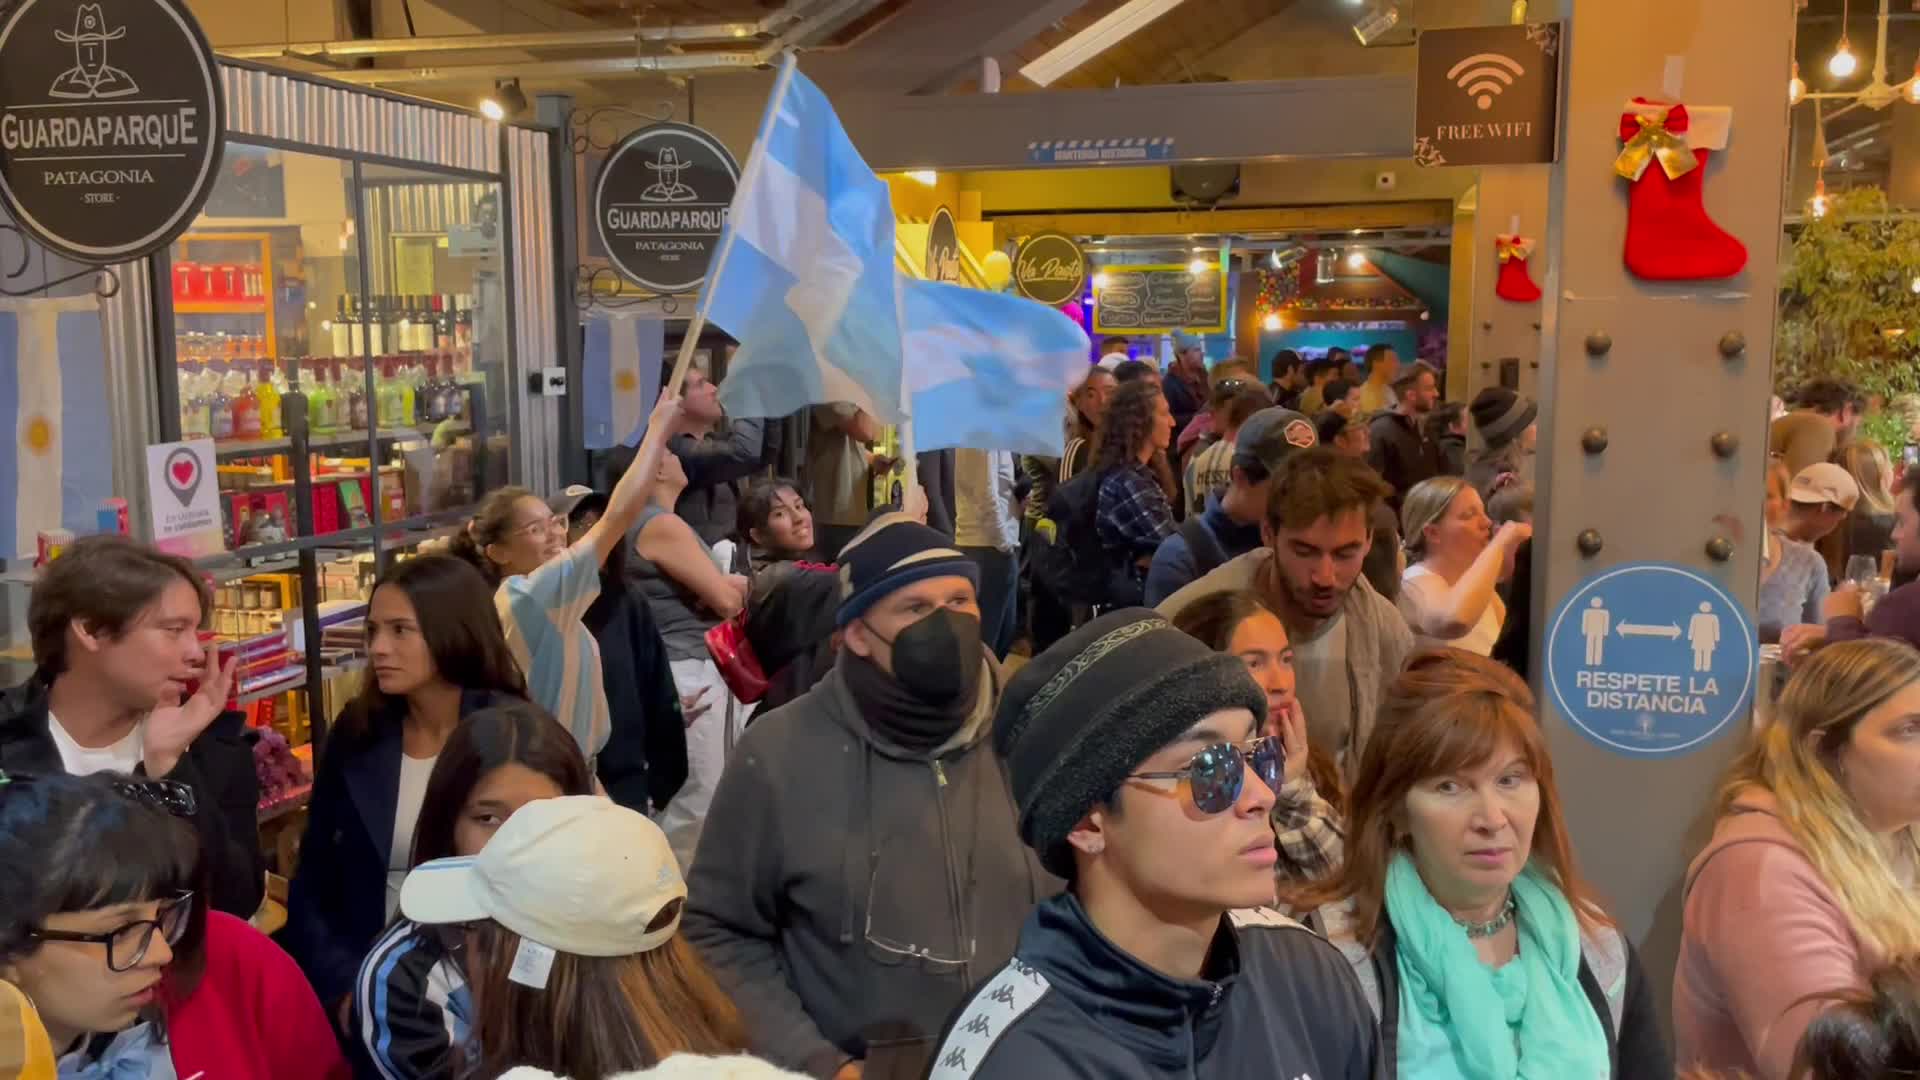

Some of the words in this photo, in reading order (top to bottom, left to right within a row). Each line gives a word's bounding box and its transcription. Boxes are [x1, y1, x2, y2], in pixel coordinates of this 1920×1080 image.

[1, 107, 198, 150] GUARDAPARQUE
[1436, 124, 1484, 140] FREE
[1486, 121, 1532, 137] WIFI
[43, 169, 154, 185] PATAGONIA
[635, 241, 704, 251] PATAGONIA
[1576, 671, 1681, 694] RESPETE
[1688, 677, 1720, 696] LA
[1586, 691, 1707, 714] DISTANCIA
